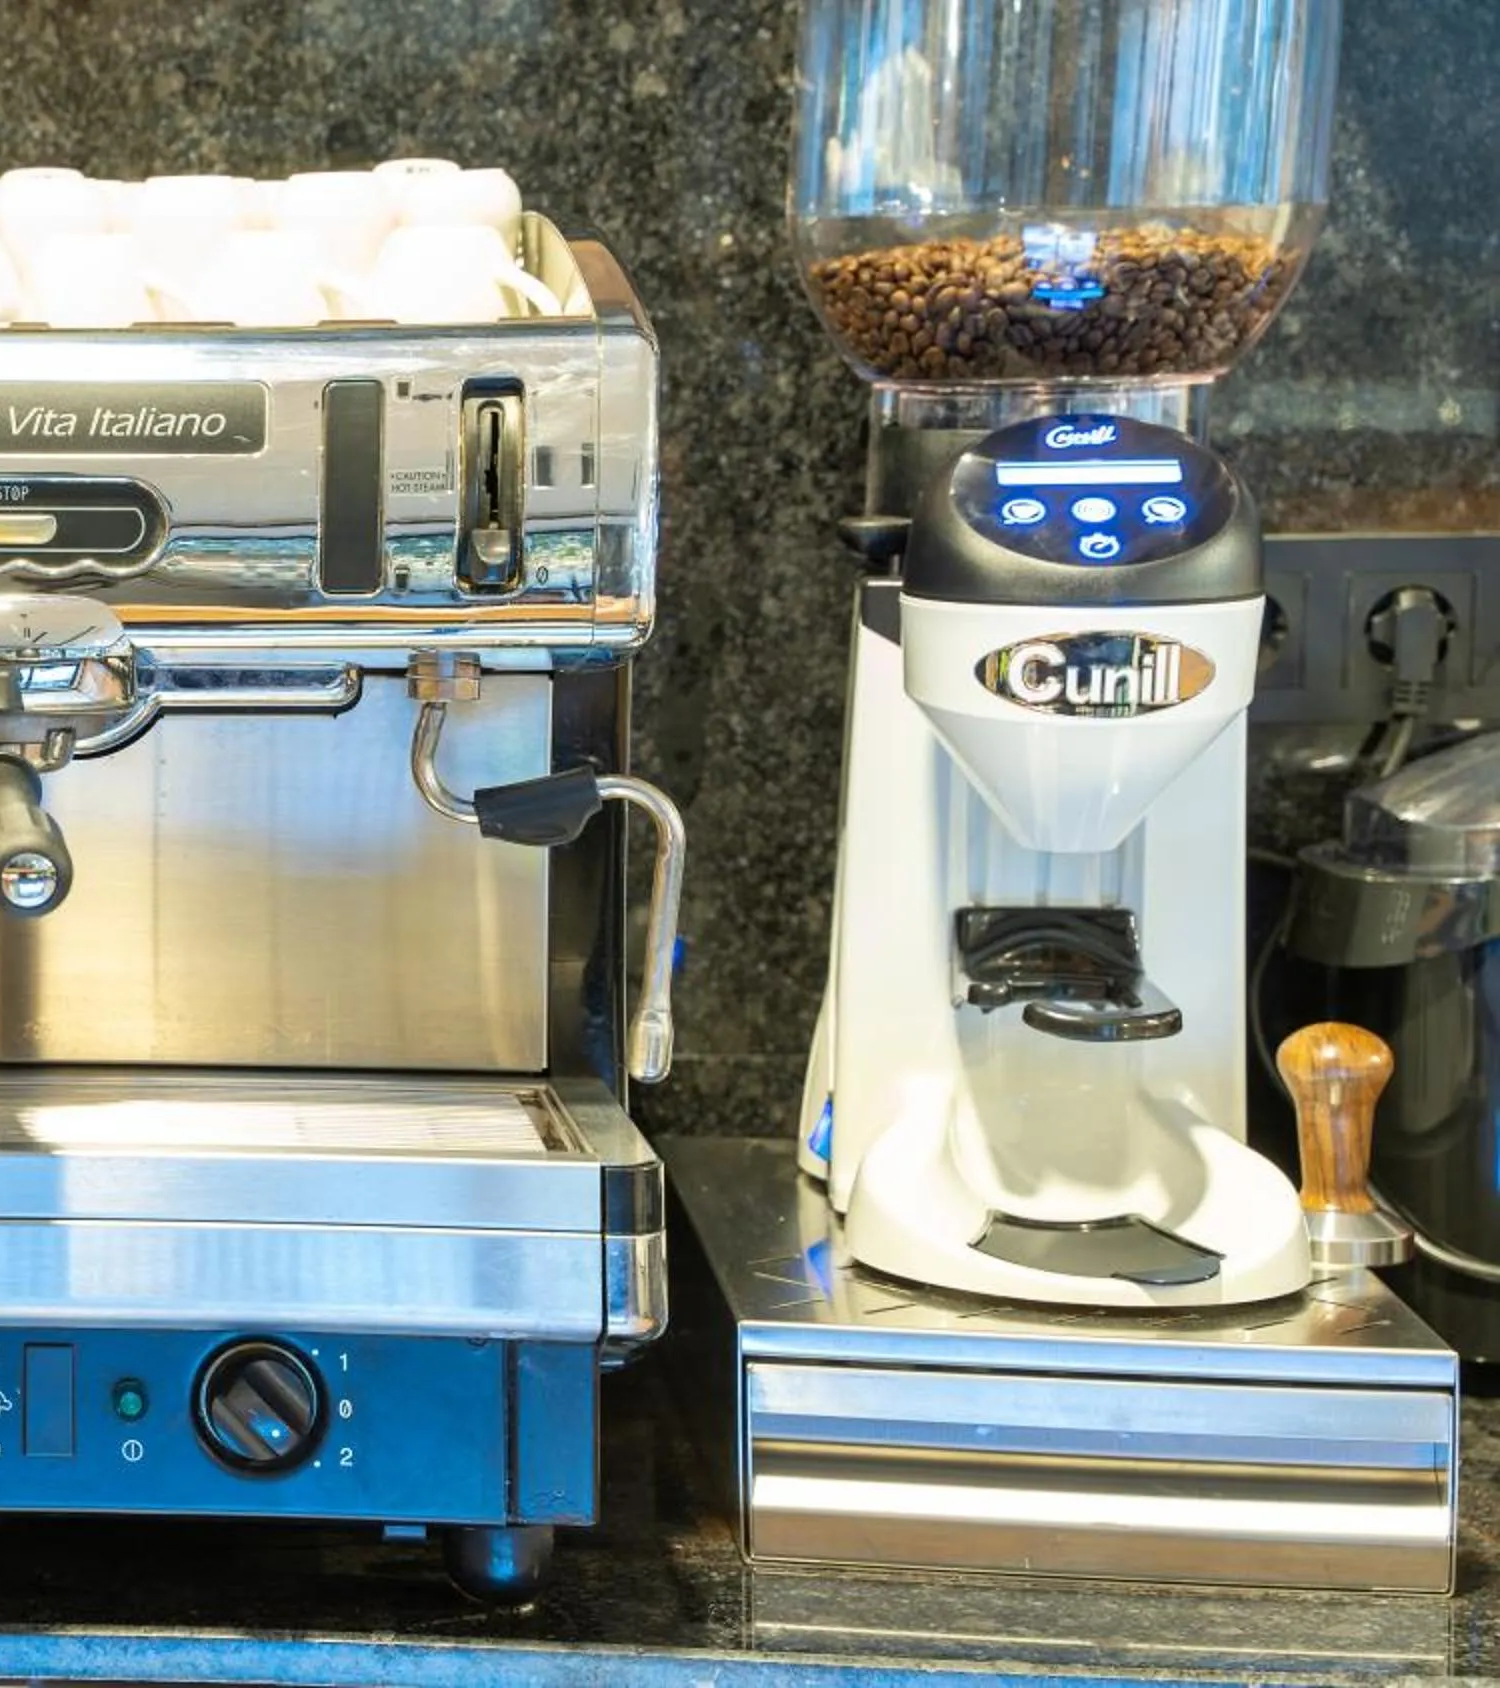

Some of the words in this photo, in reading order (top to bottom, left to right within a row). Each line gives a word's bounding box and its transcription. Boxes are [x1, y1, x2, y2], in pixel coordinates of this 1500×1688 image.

[8, 406, 77, 437] Vita
[88, 407, 226, 437] Italiano
[1007, 642, 1182, 705] Cunill
[339, 1447, 354, 1468] 2
